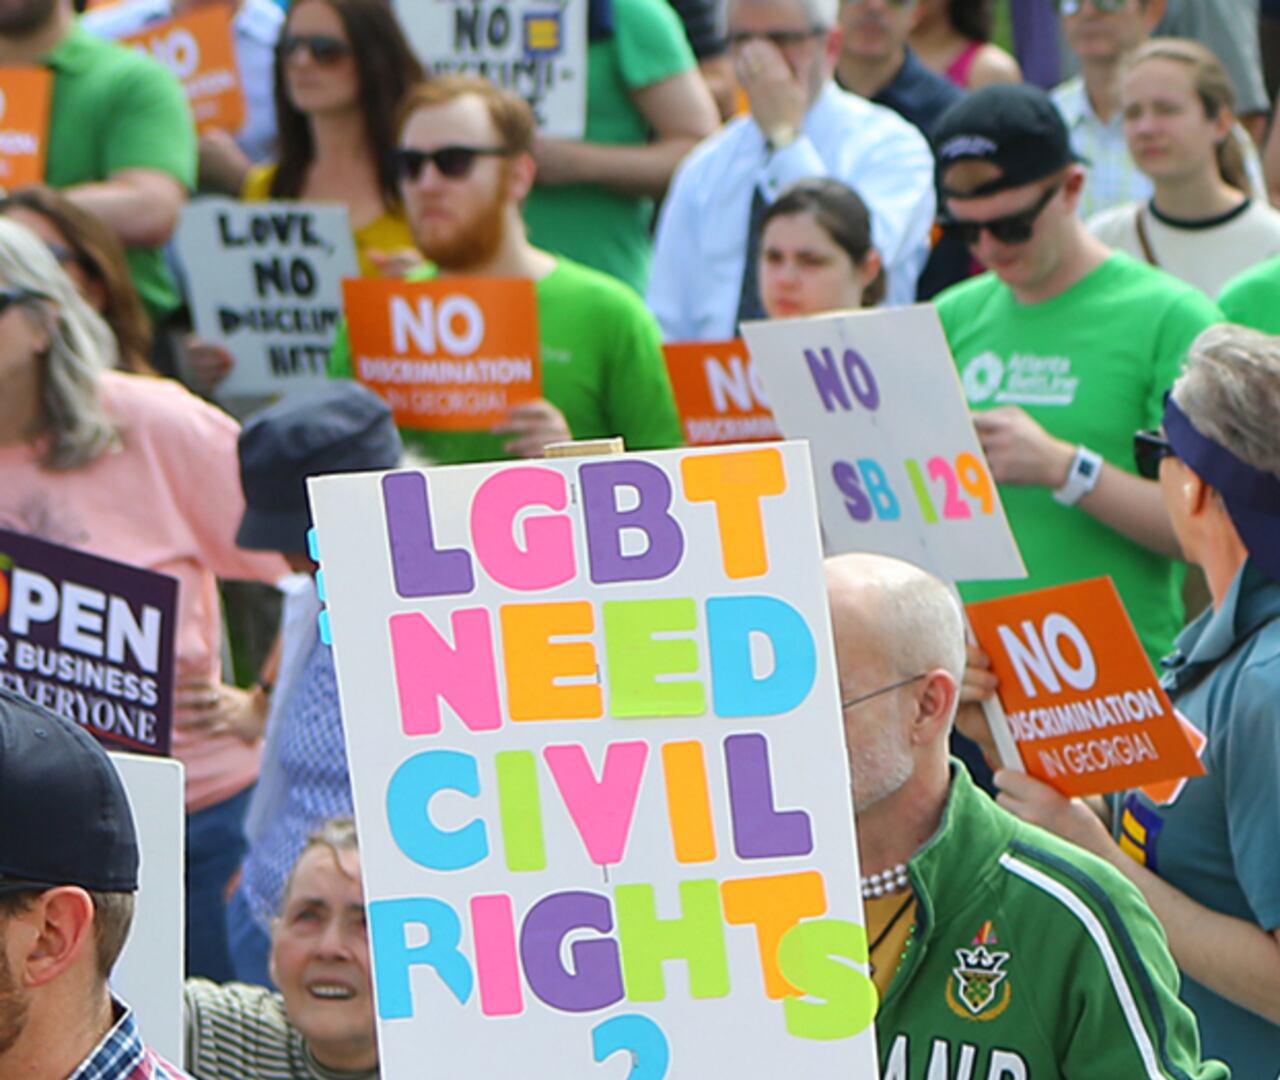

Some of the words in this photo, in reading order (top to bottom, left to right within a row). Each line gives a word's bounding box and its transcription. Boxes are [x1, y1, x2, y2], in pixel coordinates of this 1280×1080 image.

[253, 256, 316, 298] NO
[390, 294, 486, 356] NO
[803, 347, 881, 412] NO
[381, 447, 787, 599] LGBT
[832, 458, 902, 523] SB
[904, 451, 995, 525] 129
[14, 639, 159, 708] BUSINESS
[388, 594, 817, 737] NEED
[997, 612, 1097, 698] NO
[1037, 748, 1067, 778] IN
[385, 732, 814, 873] CIVIL
[368, 869, 879, 1042] RIGHTS
